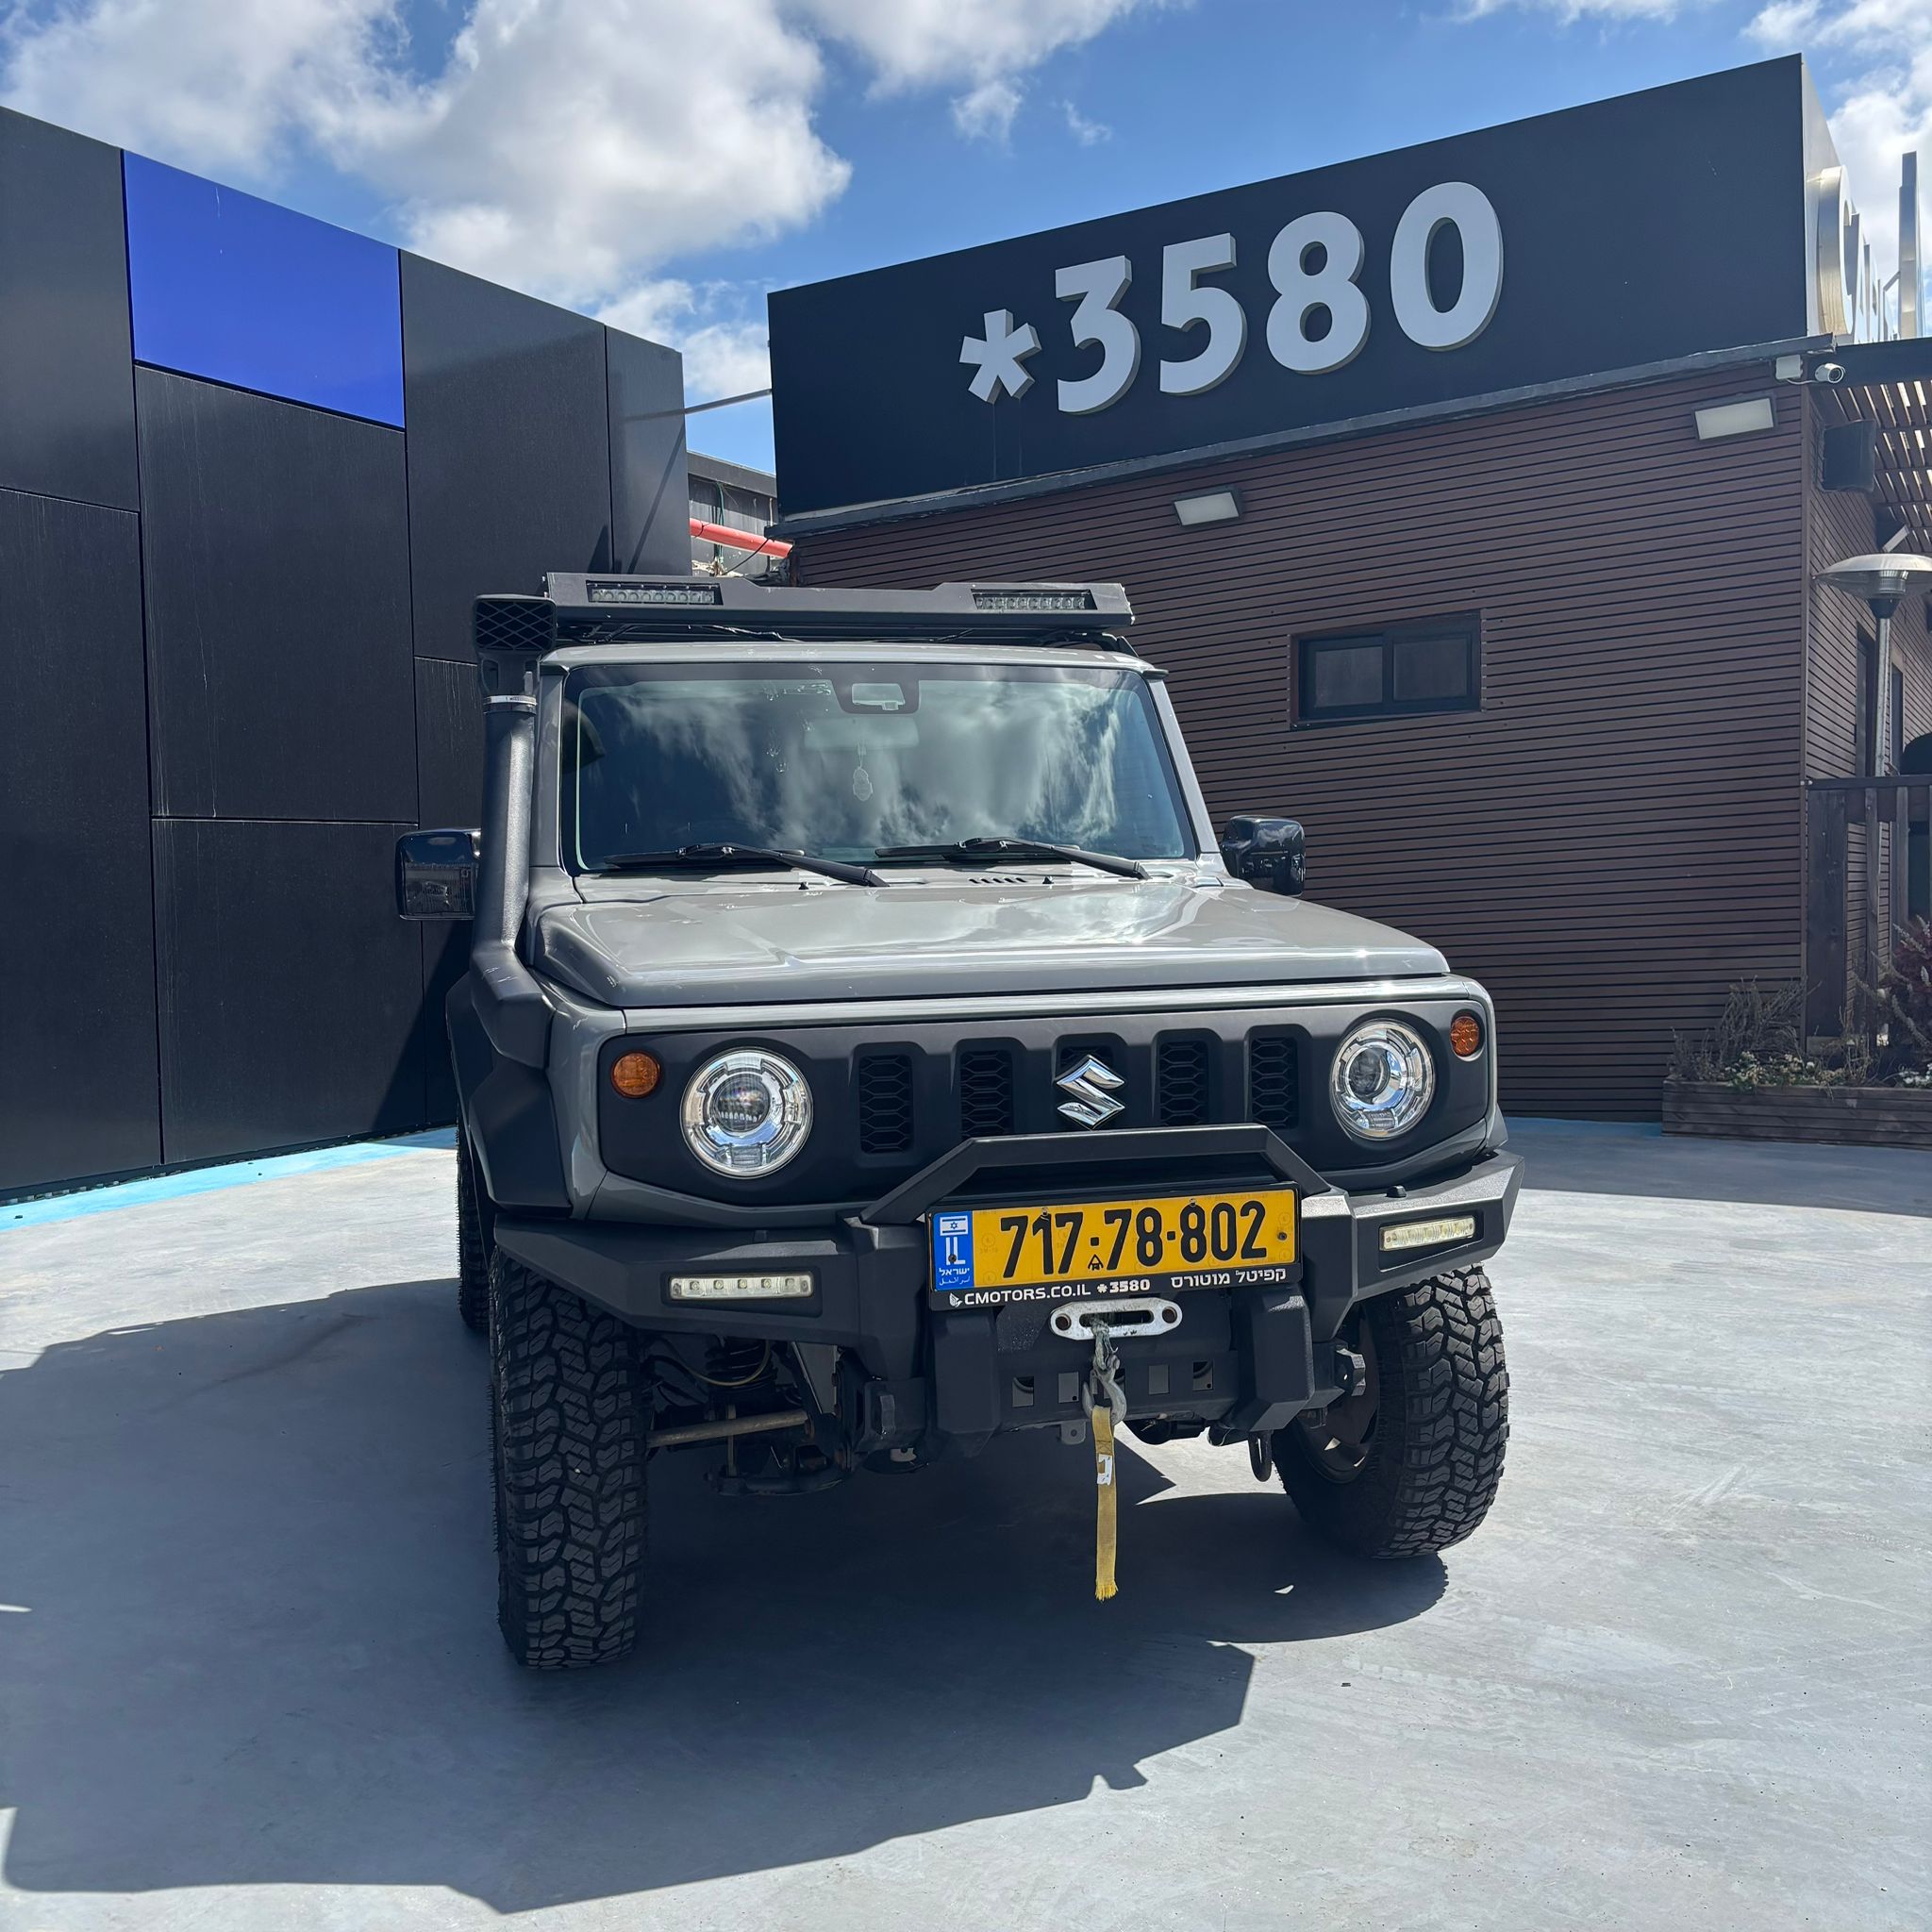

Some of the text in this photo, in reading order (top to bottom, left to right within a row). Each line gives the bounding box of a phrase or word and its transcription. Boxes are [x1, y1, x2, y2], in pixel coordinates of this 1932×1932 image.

[945, 1236, 966, 1266] IL
[939, 1267, 970, 1276] ישראל
[1170, 1268, 1287, 1289] קפיטל מוטורס
[964, 1284, 1091, 1305] CMOTORS.CO.IL
